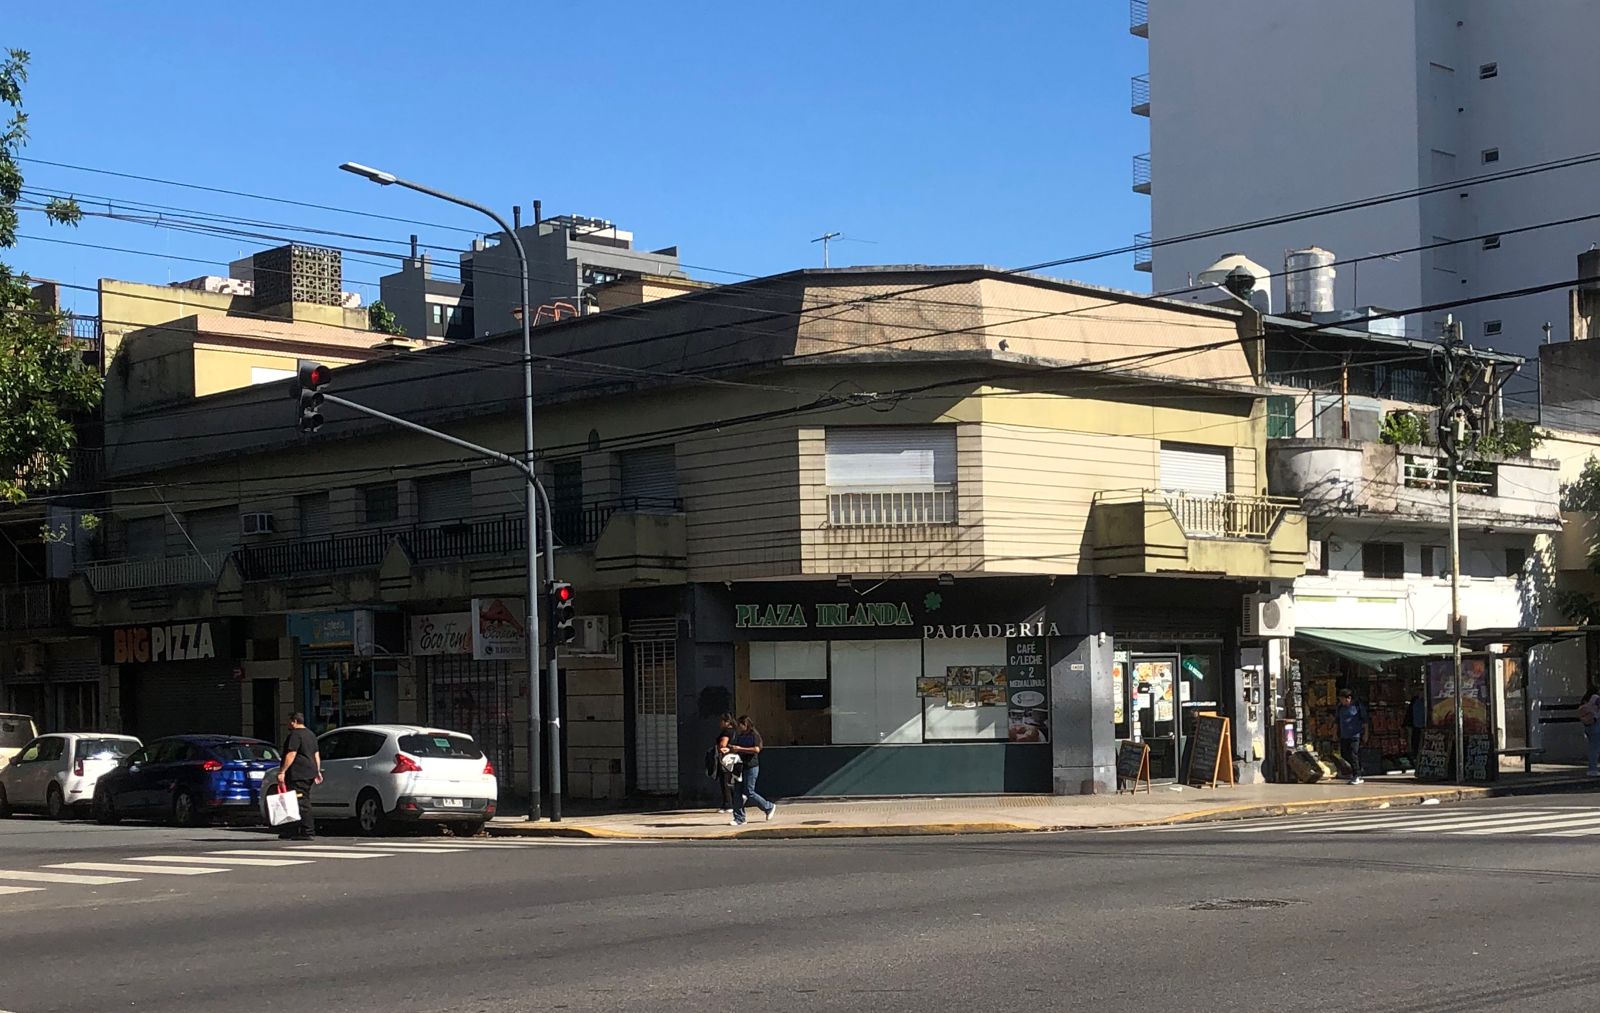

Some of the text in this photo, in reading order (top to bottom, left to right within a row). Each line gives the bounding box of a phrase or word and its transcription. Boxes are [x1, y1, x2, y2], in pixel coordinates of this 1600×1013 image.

[735, 602, 913, 627] PLAZA IRLANDA
[923, 617, 1060, 638] PANADERÍA
[113, 622, 215, 664] BIG PIZZA
[1016, 641, 1036, 654] CAFÉ
[1010, 655, 1043, 666] C/LECHE
[1028, 667, 1034, 678] 2
[1009, 679, 1045, 688] MEDIALUNAS
